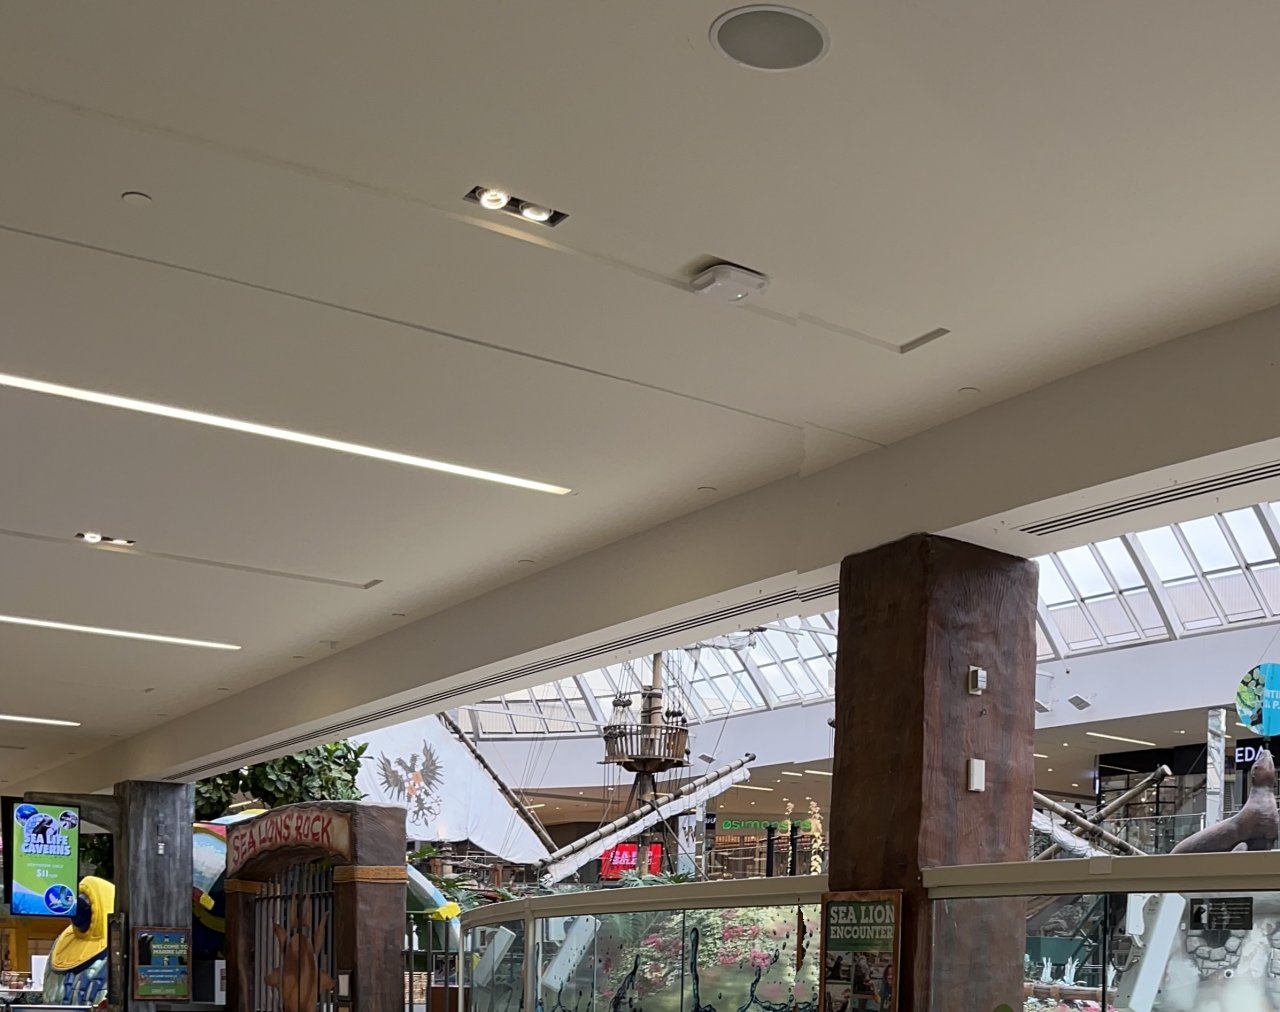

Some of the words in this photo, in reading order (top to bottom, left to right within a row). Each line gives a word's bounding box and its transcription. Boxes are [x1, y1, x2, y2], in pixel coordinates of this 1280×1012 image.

[24, 833, 44, 844] SEA
[46, 835, 68, 846] LIFE
[233, 829, 256, 866] SEA
[295, 814, 333, 847] ROCK
[23, 843, 71, 856] CAVERNS
[830, 905, 857, 924] SEA
[860, 904, 895, 924] LION
[830, 925, 894, 939] ENCOUNTER
